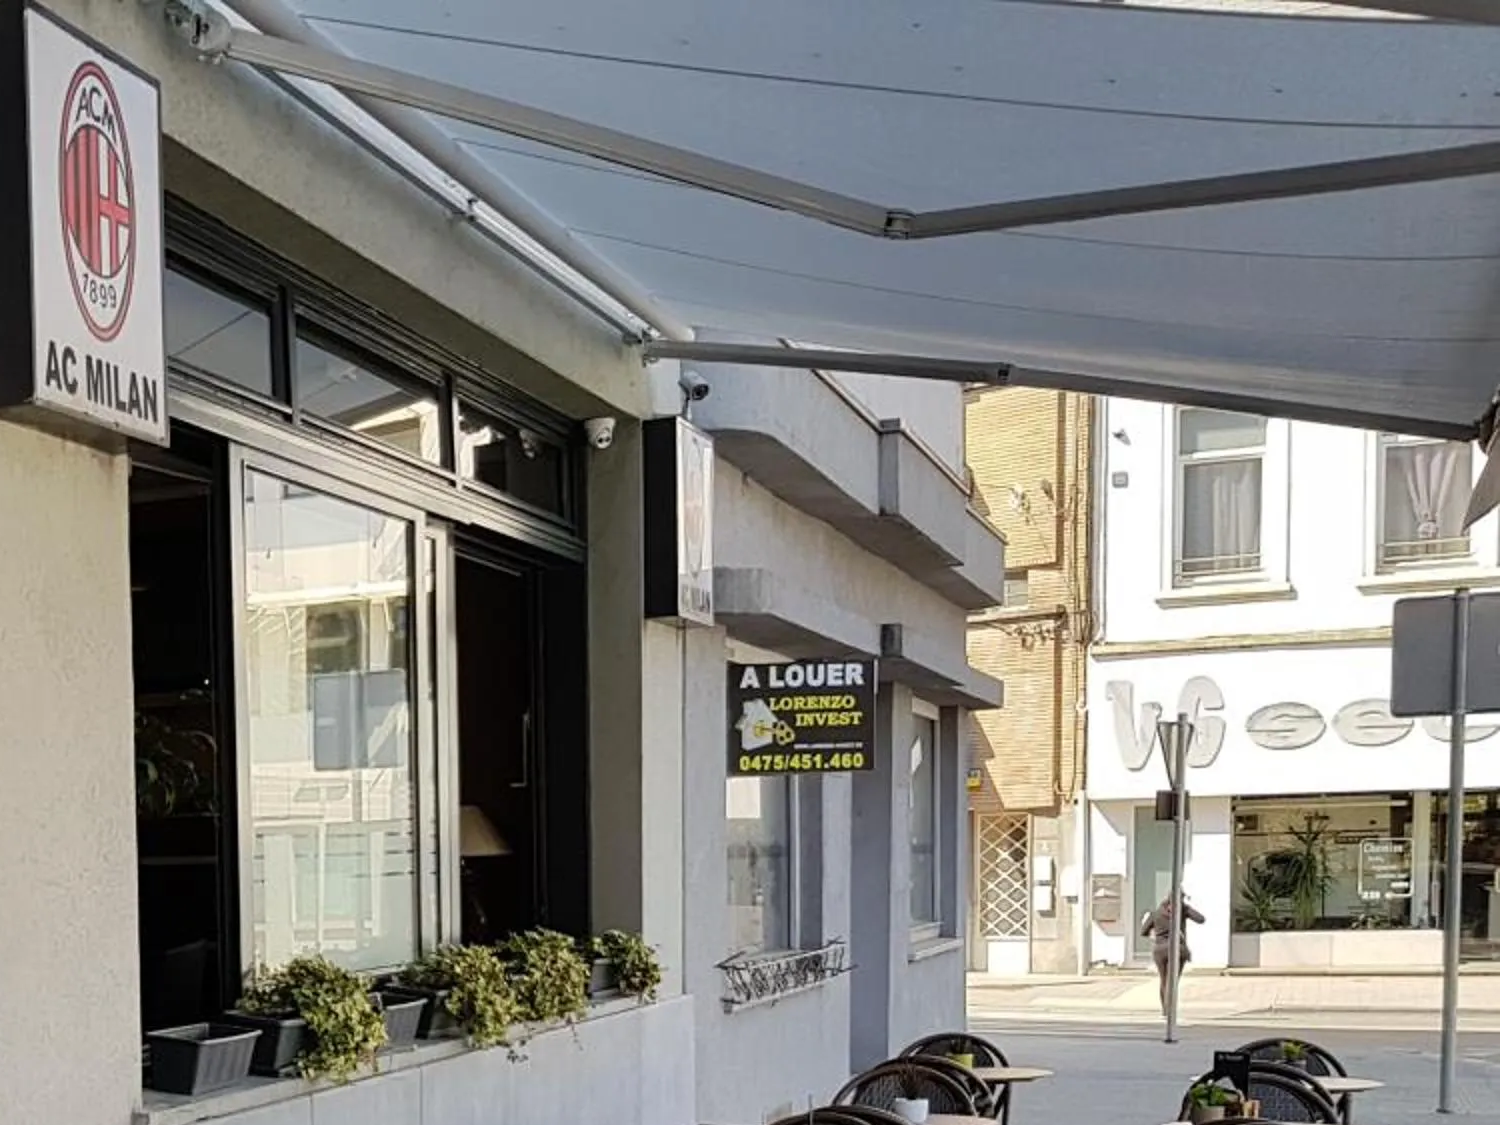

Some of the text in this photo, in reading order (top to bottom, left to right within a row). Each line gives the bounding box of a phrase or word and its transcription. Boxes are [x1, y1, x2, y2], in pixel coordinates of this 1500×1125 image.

[76, 86, 117, 144] ACM
[81, 273, 117, 309] 1899
[45, 340, 159, 424] AC MILAN
[740, 663, 865, 689] A LOUER
[769, 695, 856, 711] LORENZO
[795, 712, 863, 727] INVEST
